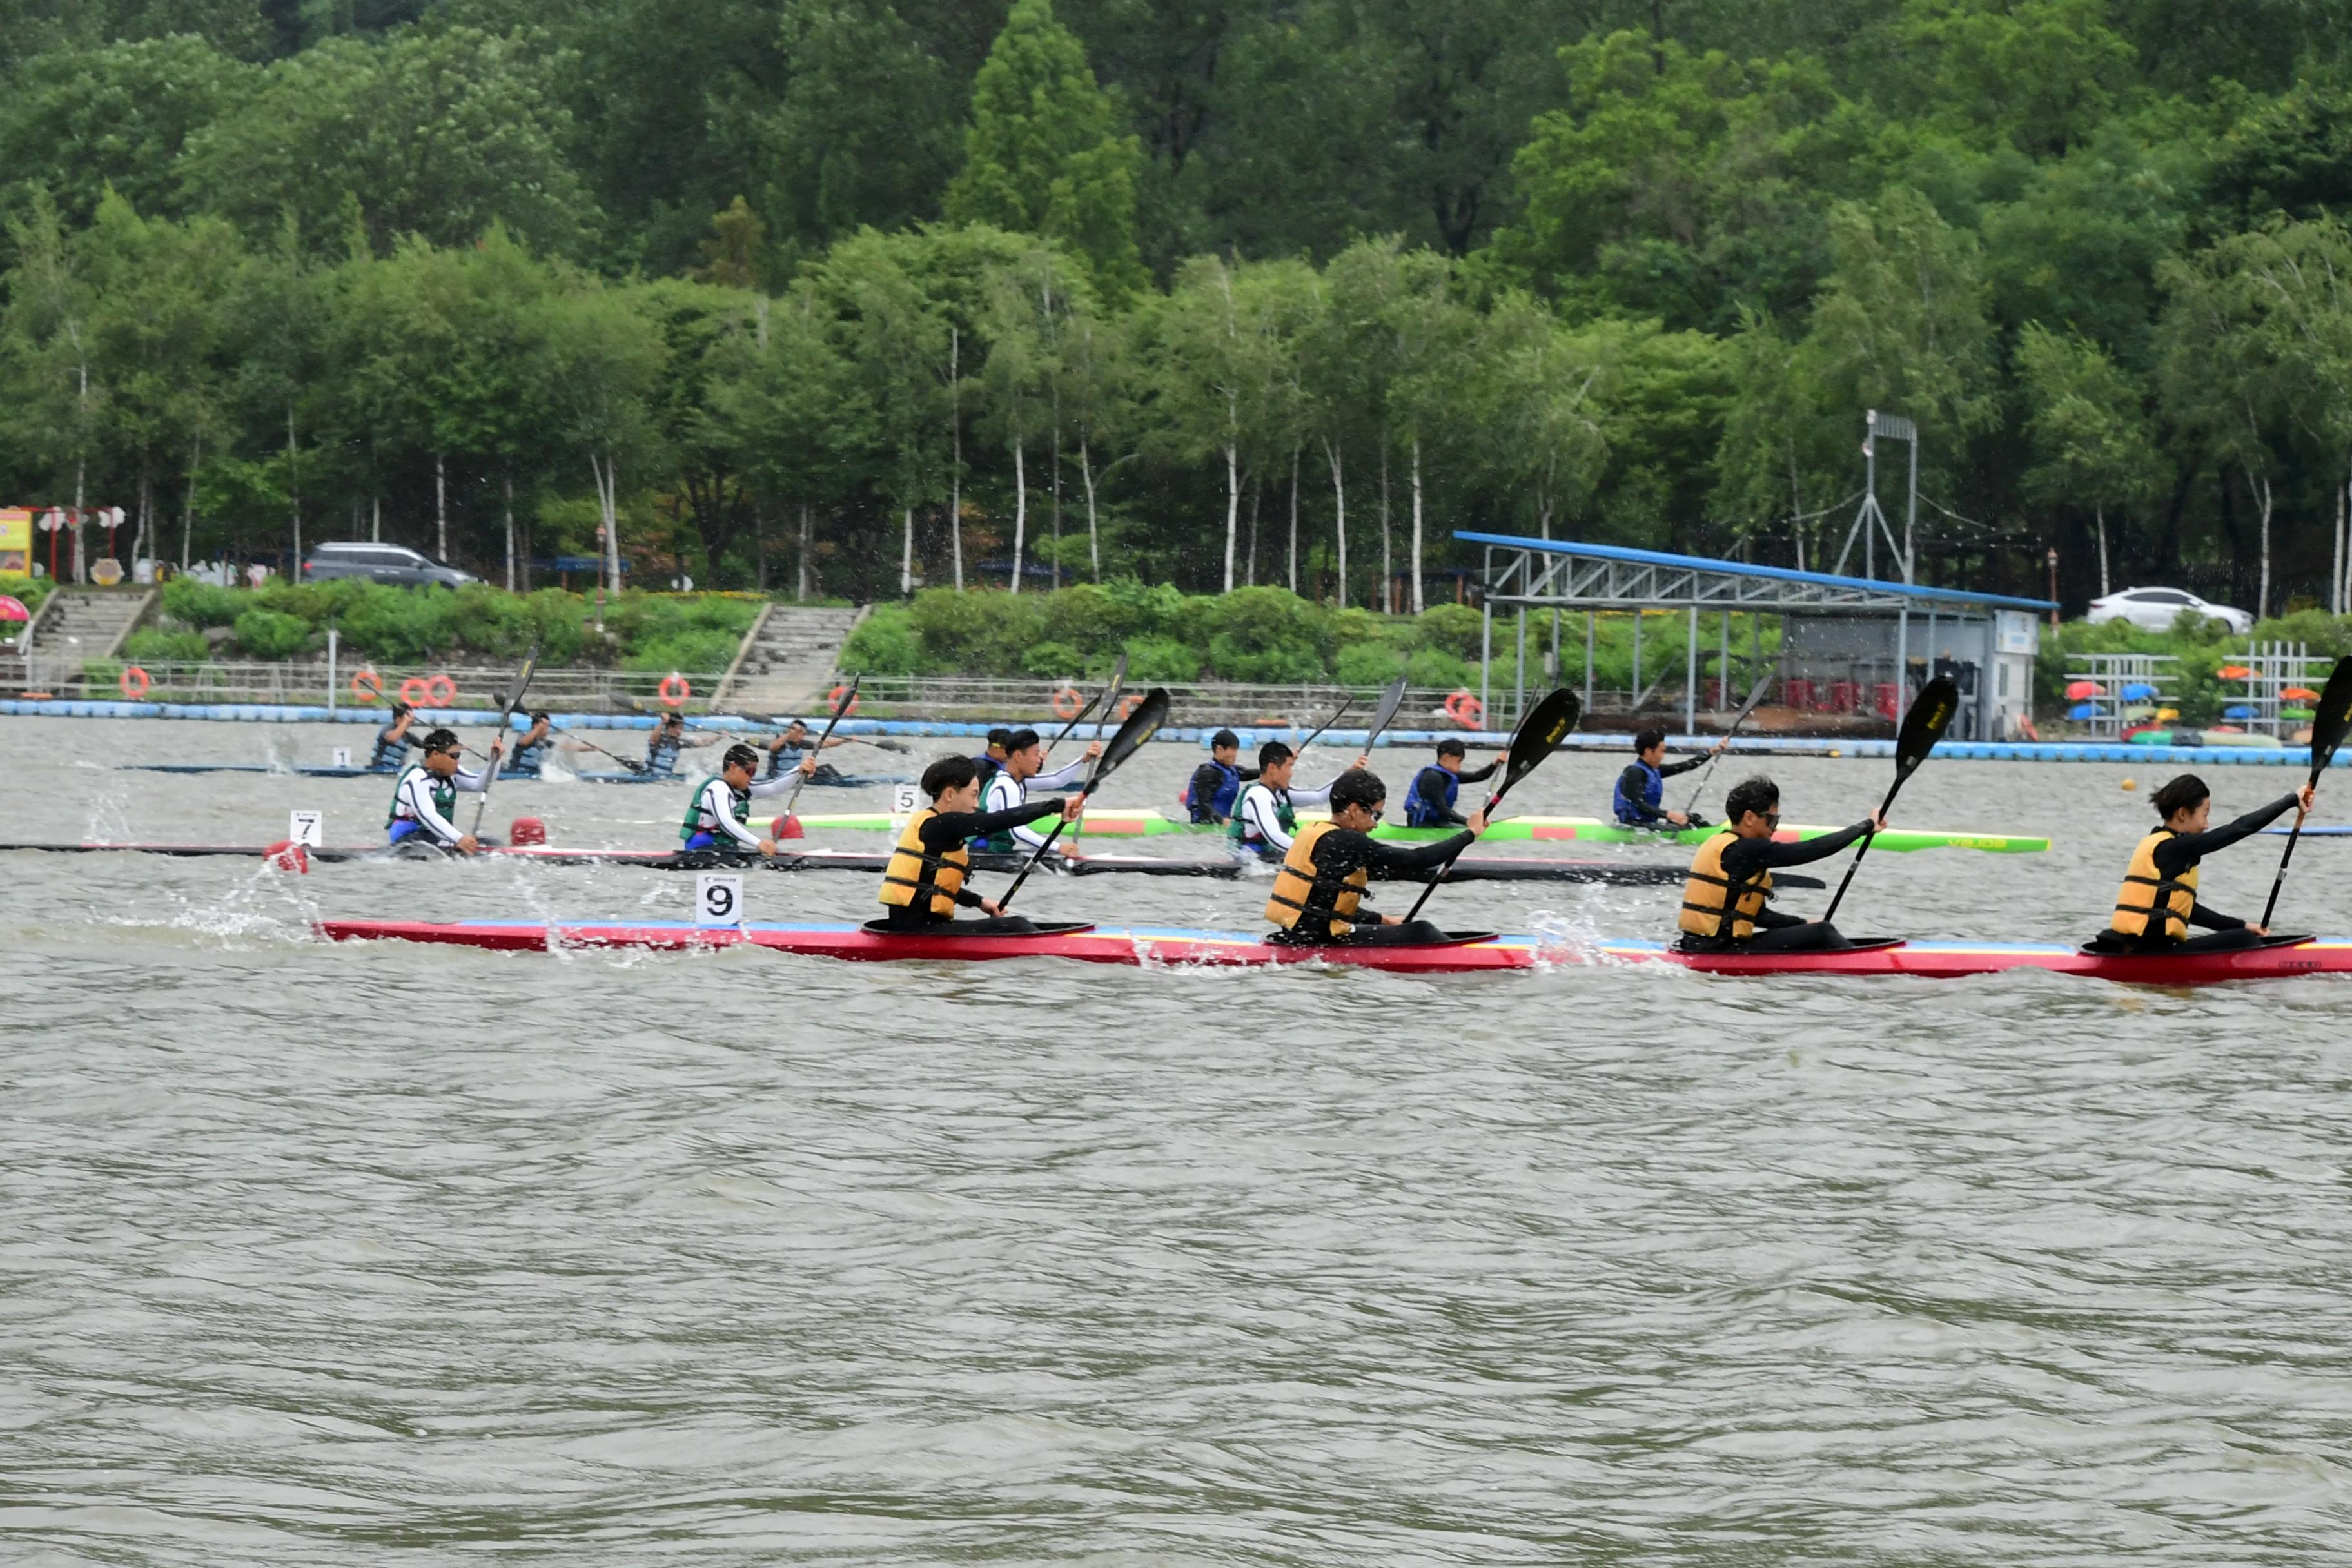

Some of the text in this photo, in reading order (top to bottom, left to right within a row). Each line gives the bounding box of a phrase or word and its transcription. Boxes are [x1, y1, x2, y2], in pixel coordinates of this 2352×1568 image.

[901, 792, 914, 808] 5
[298, 818, 315, 839] 7
[707, 885, 734, 916] 9
